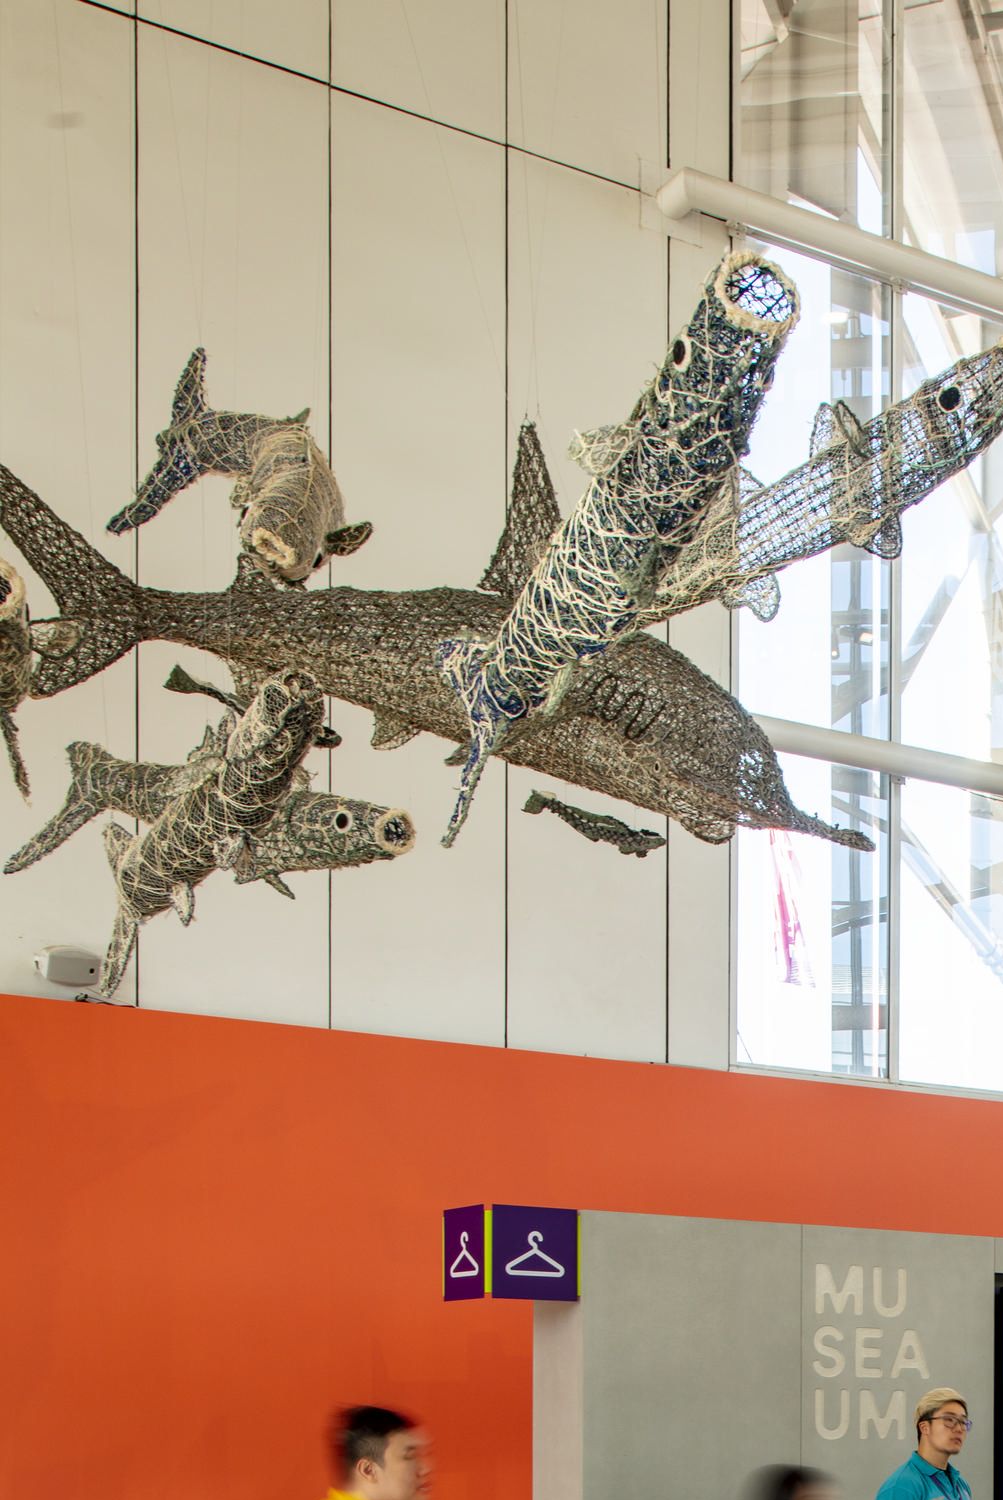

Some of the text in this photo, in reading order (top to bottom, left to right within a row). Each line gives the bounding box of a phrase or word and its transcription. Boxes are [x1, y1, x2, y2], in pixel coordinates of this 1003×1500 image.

[815, 1263, 907, 1318] MU
[813, 1325, 930, 1379] SEA
[814, 1389, 907, 1440] UM
